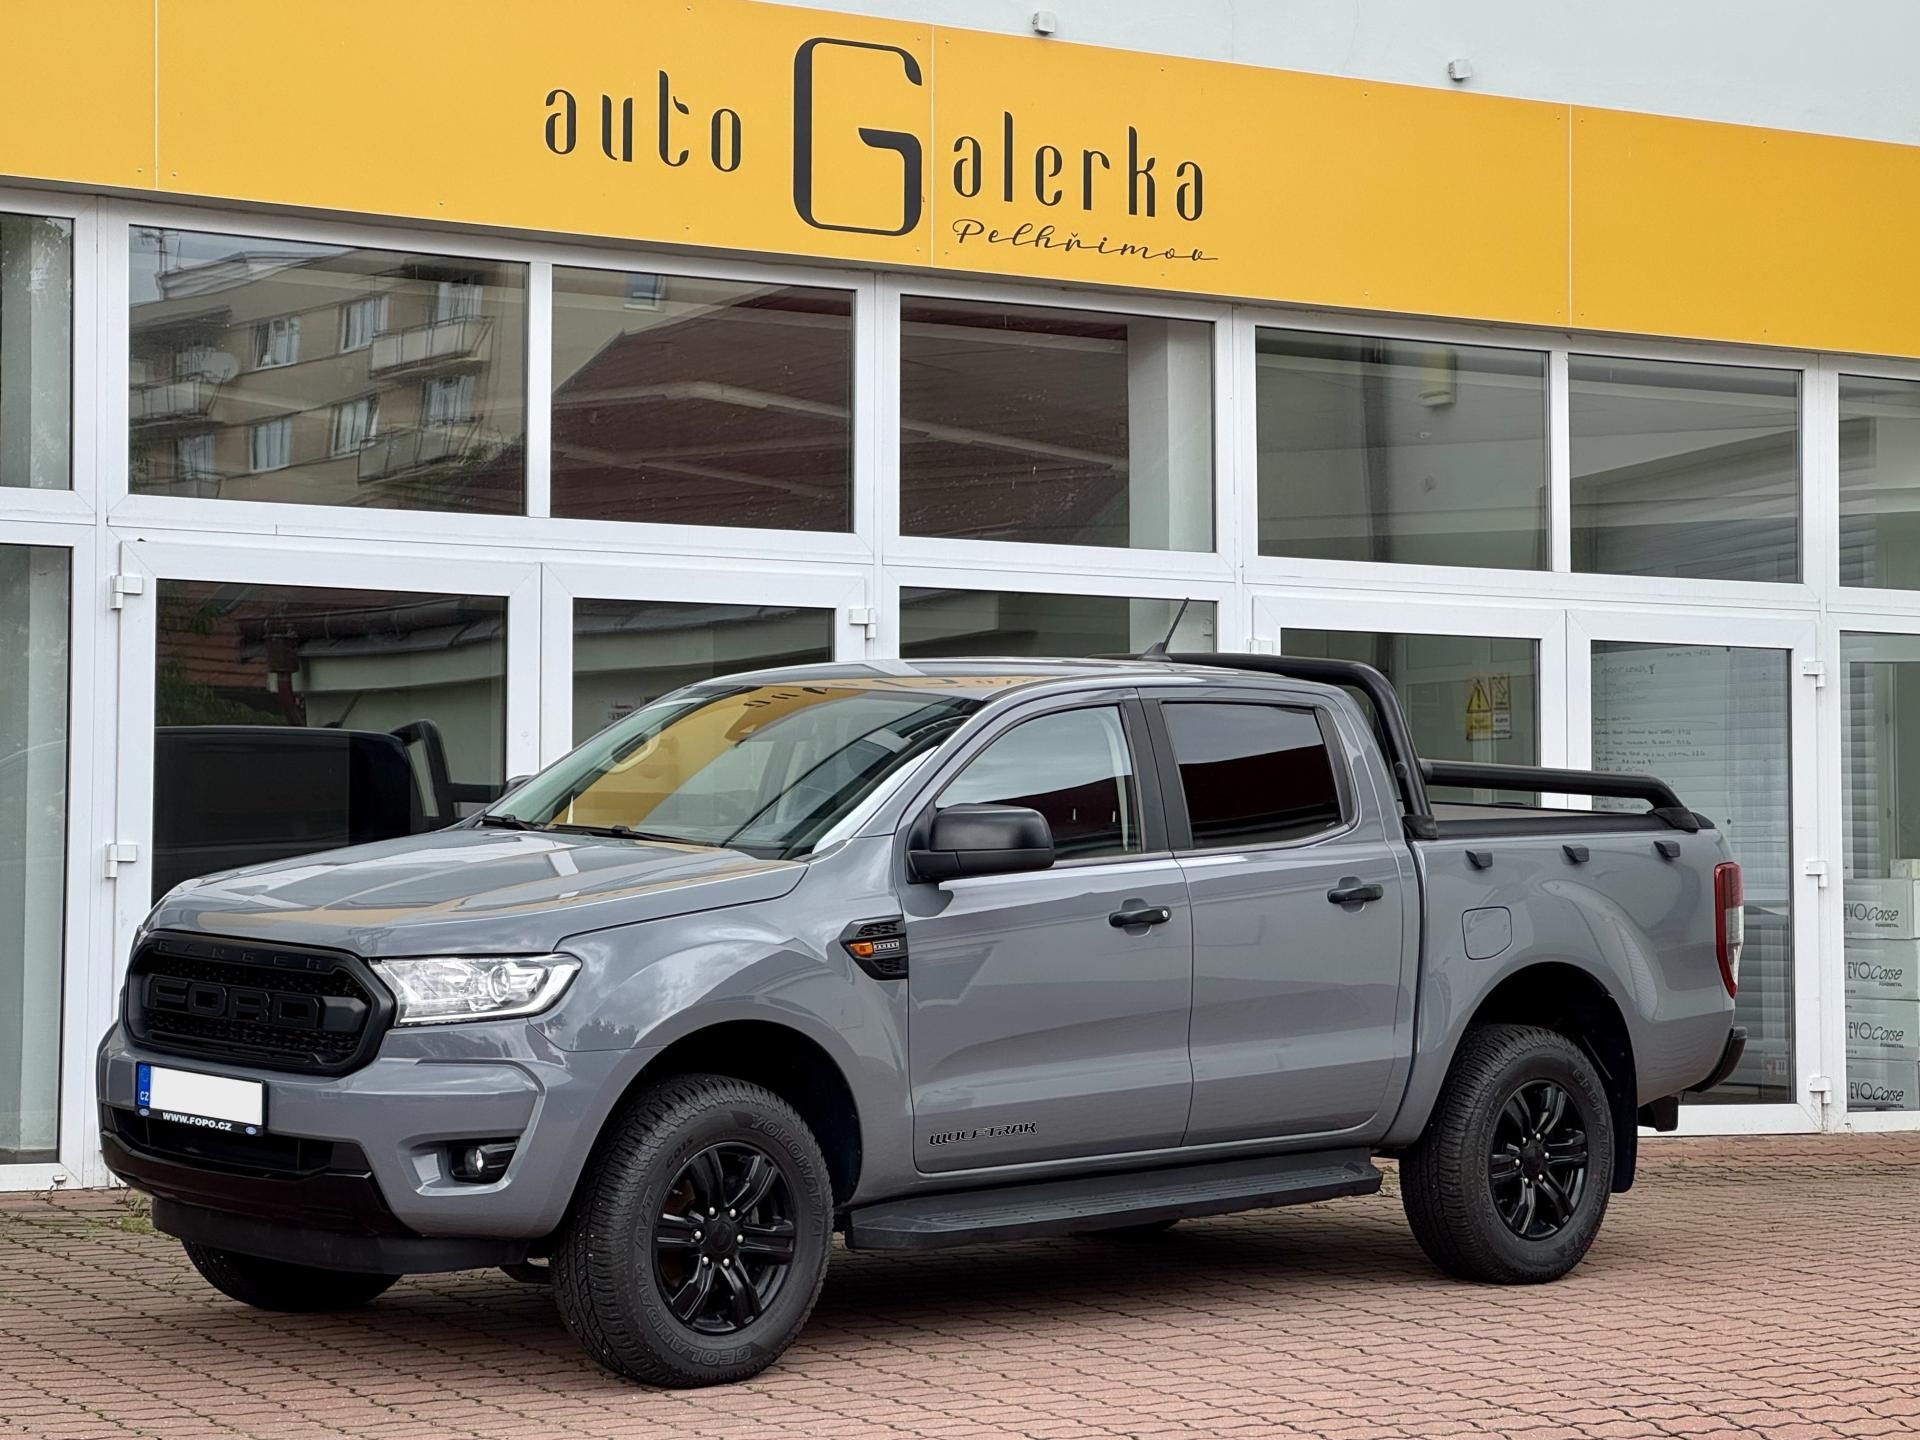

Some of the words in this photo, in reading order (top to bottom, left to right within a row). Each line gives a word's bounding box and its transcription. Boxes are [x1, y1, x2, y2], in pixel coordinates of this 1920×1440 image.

[545, 70, 742, 173] auto
[793, 37, 1205, 237] Galerka
[952, 218, 1219, 262] Pelhřimov
[148, 973, 320, 1030] FORD
[140, 1091, 149, 1101] CZ
[162, 1111, 232, 1131] WWW.FOPO.CZ
